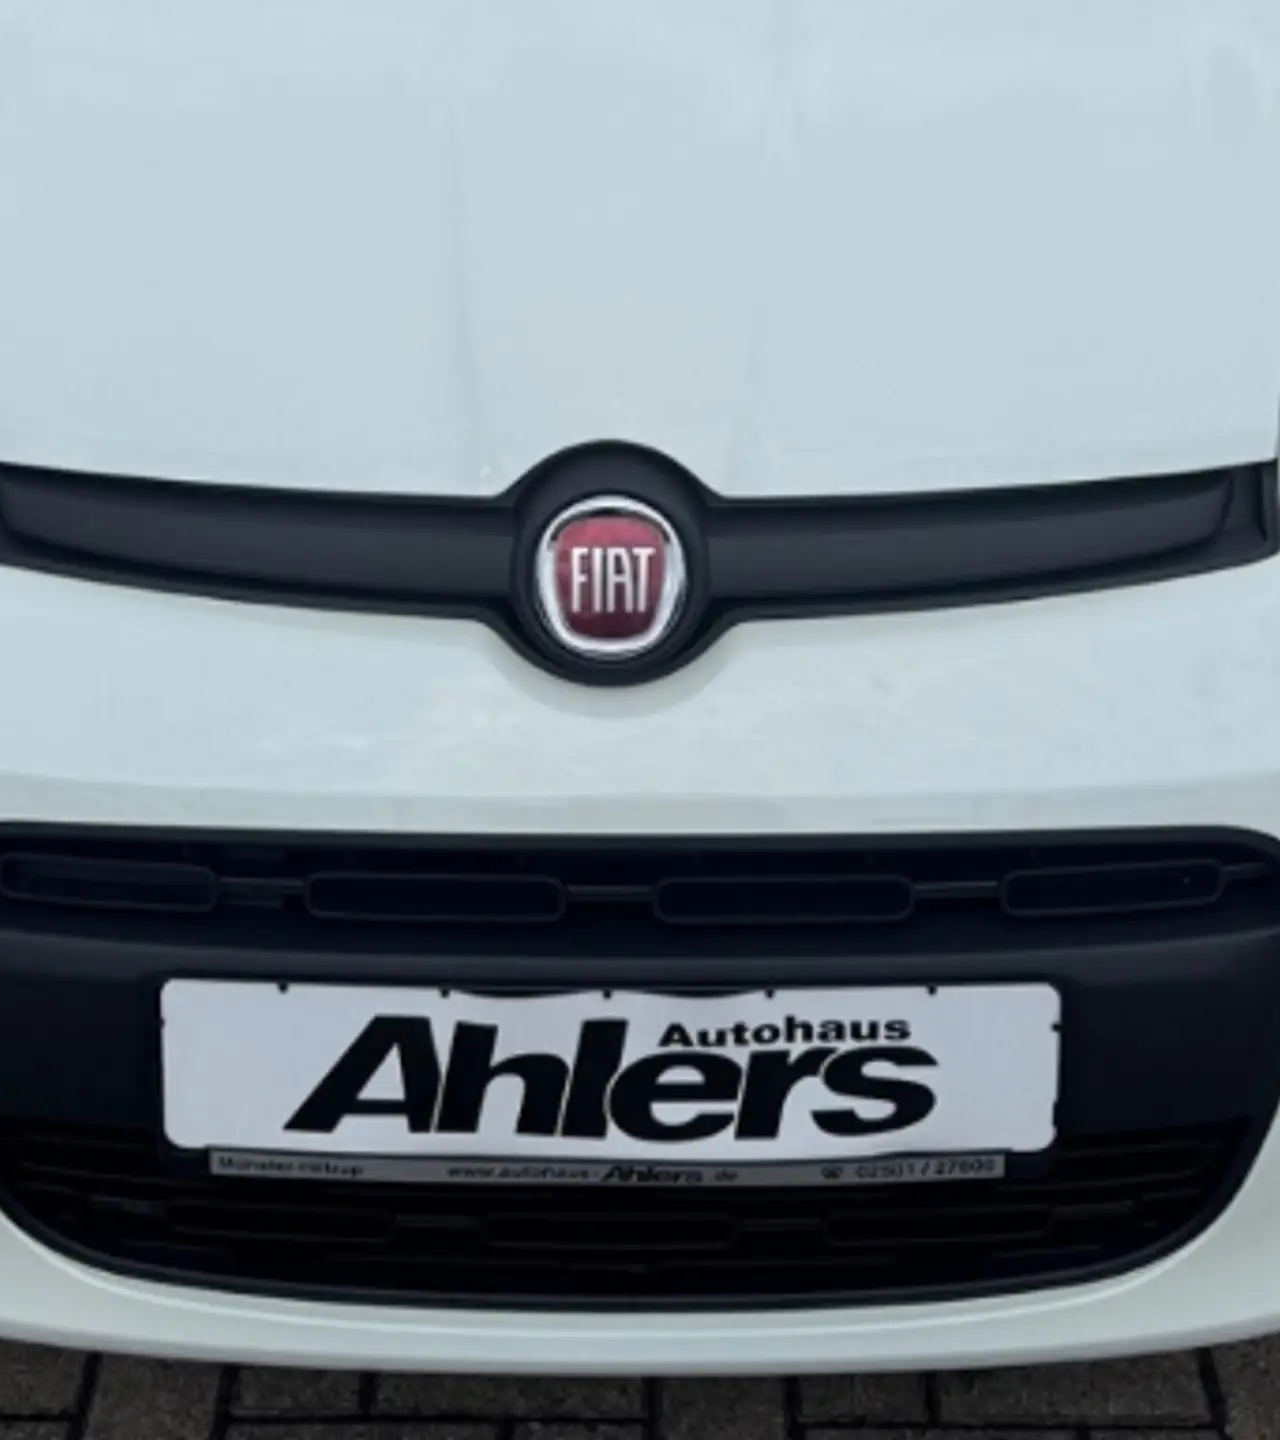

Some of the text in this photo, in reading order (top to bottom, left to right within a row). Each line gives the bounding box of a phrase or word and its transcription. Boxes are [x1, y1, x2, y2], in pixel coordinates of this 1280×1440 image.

[572, 546, 656, 614] FIAT
[658, 1018, 911, 1049] Autohaus
[282, 1015, 938, 1141] Ahlers
